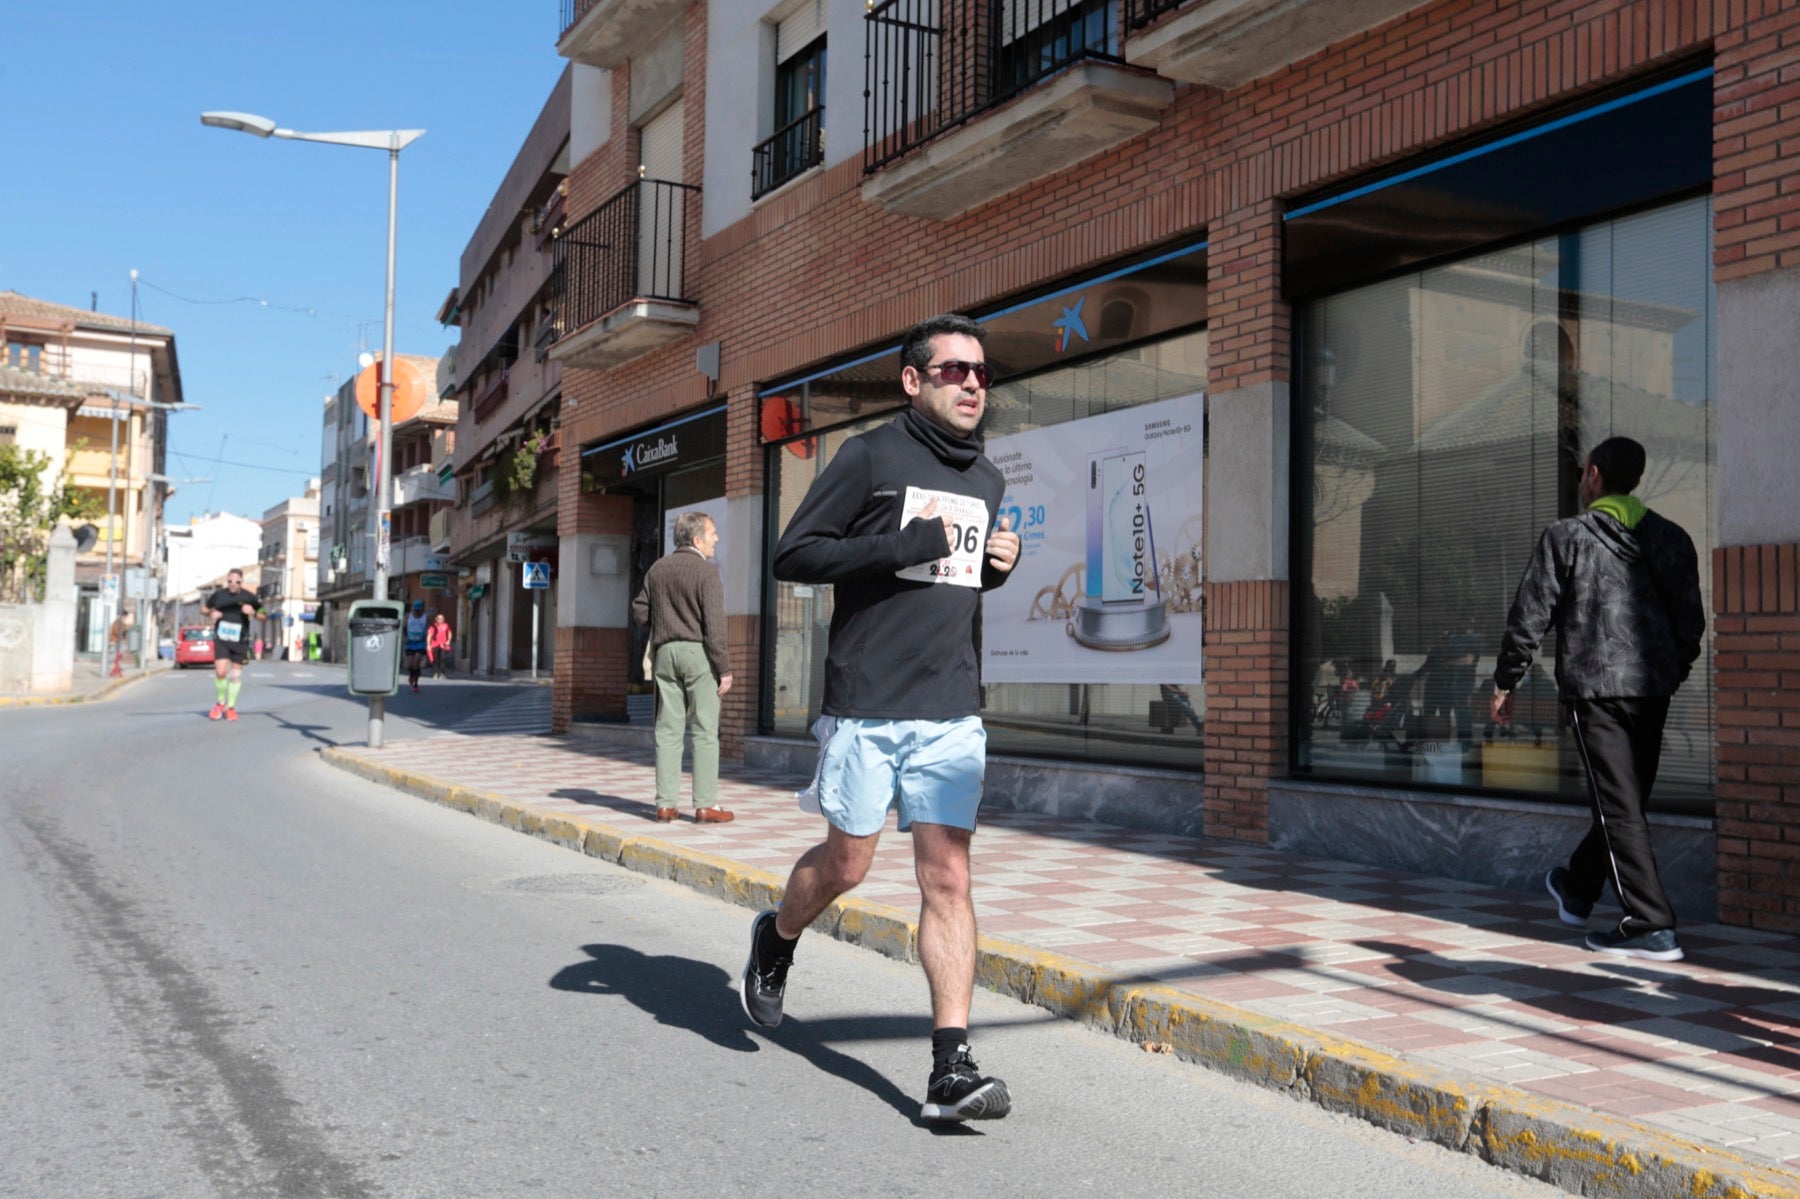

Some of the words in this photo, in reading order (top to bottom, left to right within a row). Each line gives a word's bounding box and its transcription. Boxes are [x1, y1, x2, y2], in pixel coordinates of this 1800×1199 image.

[636, 434, 678, 465] CaixaBank
[1004, 474, 1034, 486] ecnología
[1132, 463, 1145, 496] 5G
[1132, 503, 1145, 595] Note10+
